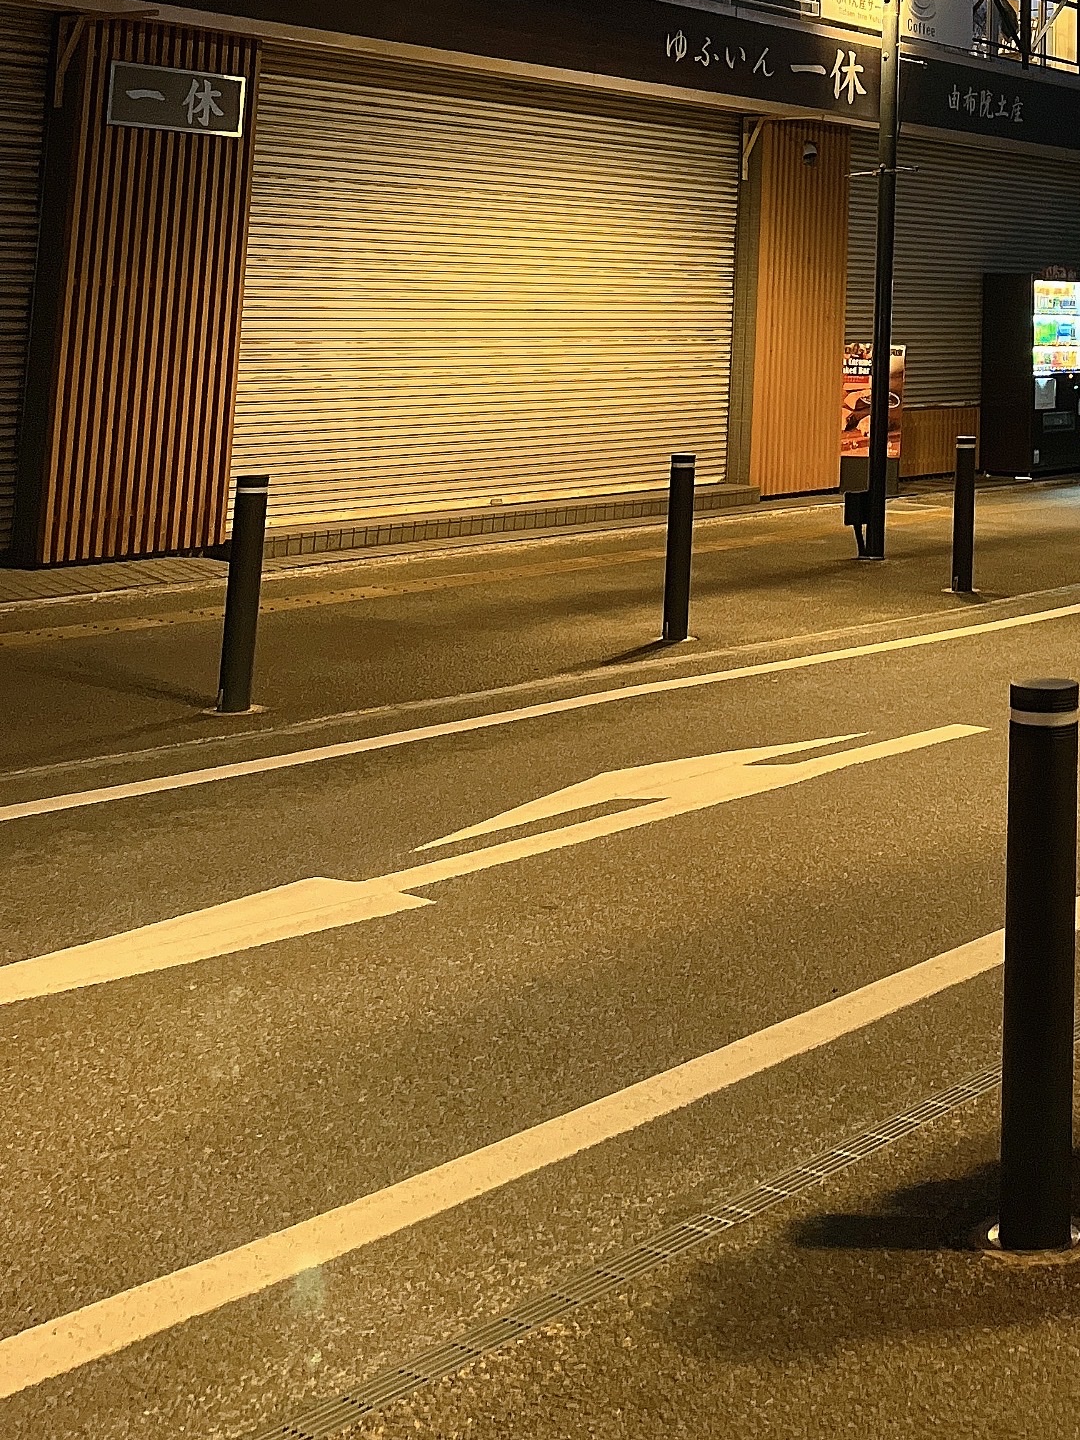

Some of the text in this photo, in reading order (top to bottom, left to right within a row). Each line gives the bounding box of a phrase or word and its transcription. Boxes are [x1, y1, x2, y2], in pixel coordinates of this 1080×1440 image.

[907, 18, 936, 38] Coffee
[666, 29, 867, 105] ゆふいん 一休
[125, 78, 224, 127] 一休
[948, 83, 1024, 123] 由布院土産
